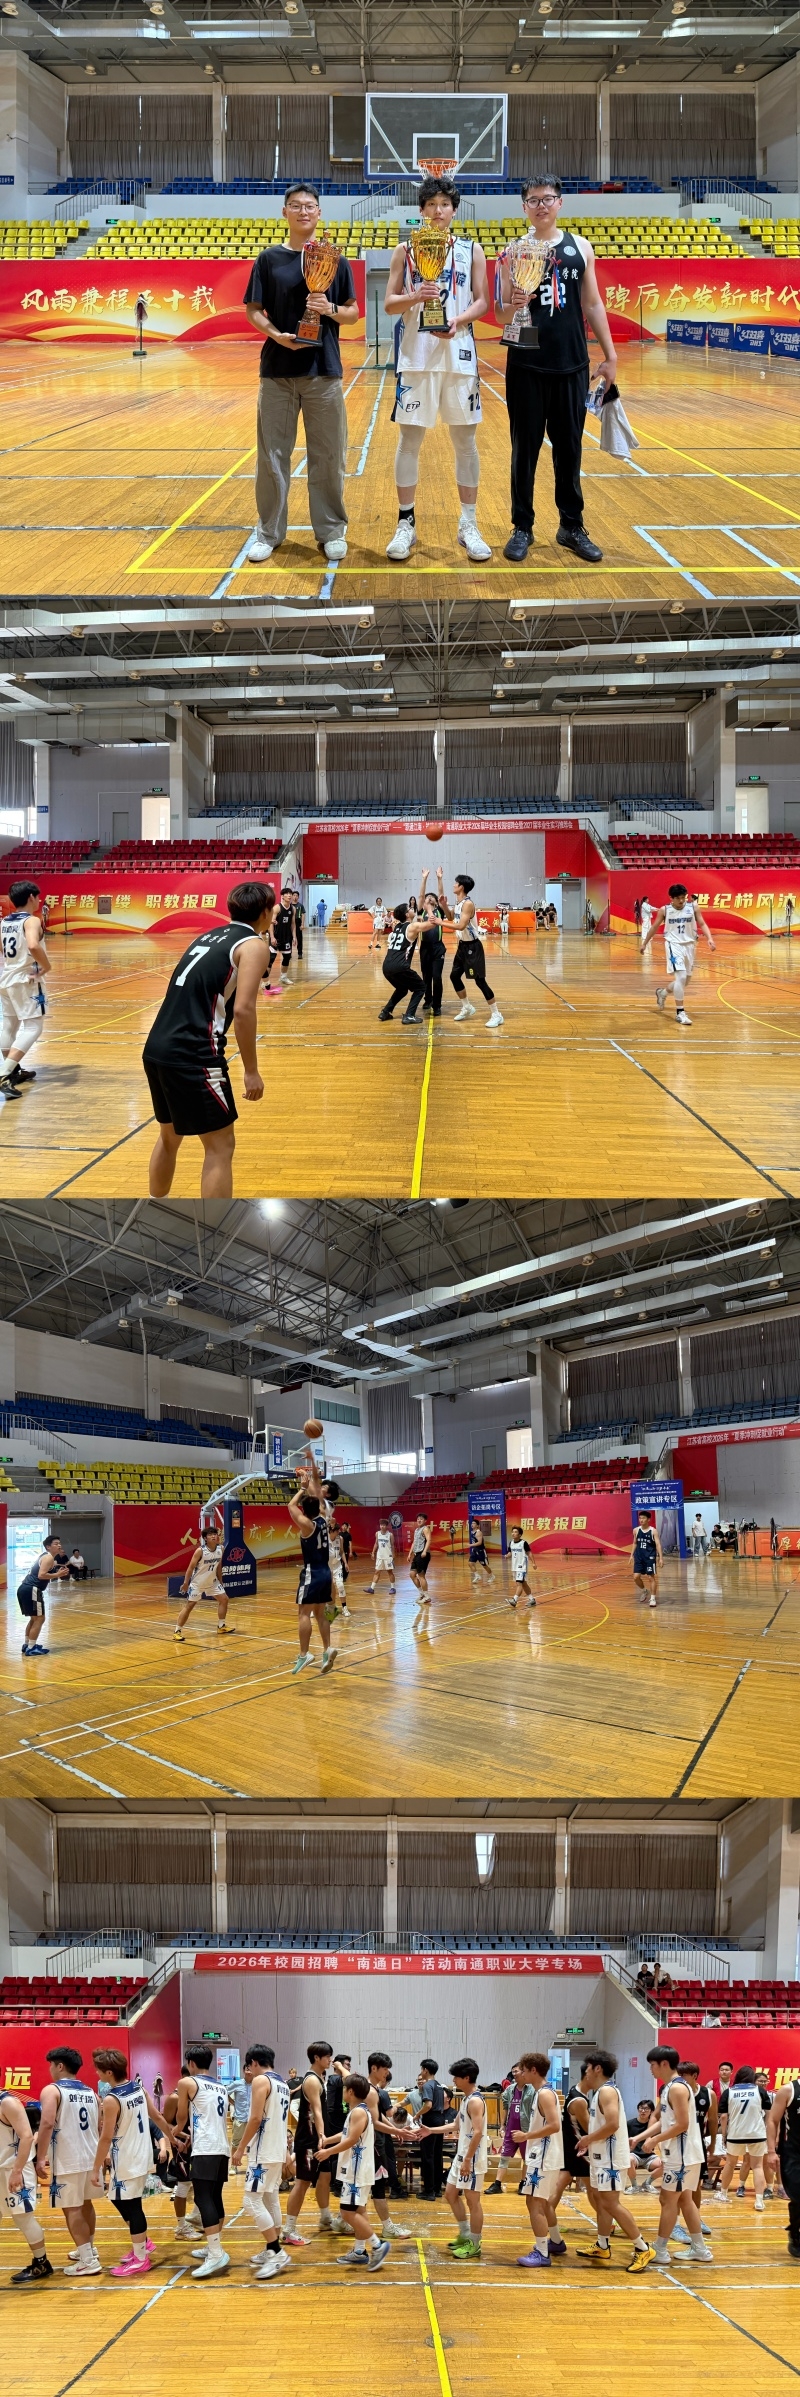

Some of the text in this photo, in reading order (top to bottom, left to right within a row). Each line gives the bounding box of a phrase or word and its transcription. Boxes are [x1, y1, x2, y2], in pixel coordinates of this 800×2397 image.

[670, 323, 684, 334] 红双
[711, 327, 730, 339] 红双喜
[739, 329, 765, 342] 红双喜
[773, 332, 800, 346] 红双喜
[468, 392, 481, 412] 12
[145, 894, 218, 909] 职教报国
[677, 924, 686, 934] 12
[2, 936, 17, 958] 13
[388, 933, 404, 950] 22
[175, 945, 211, 987] 7
[635, 1494, 678, 1504] 政策宣讲专区
[521, 1516, 588, 1531] 职教报国
[4, 2066, 32, 2090] 远
[216, 2095, 224, 2117] 8
[514, 2104, 520, 2113] 6
[740, 2099, 750, 2115] 7
[136, 2110, 144, 2134] 1
[458, 2174, 469, 2183] 30
[597, 2173, 604, 2184] 11
[663, 2172, 672, 2184] 19
[5, 2196, 16, 2208] 13
